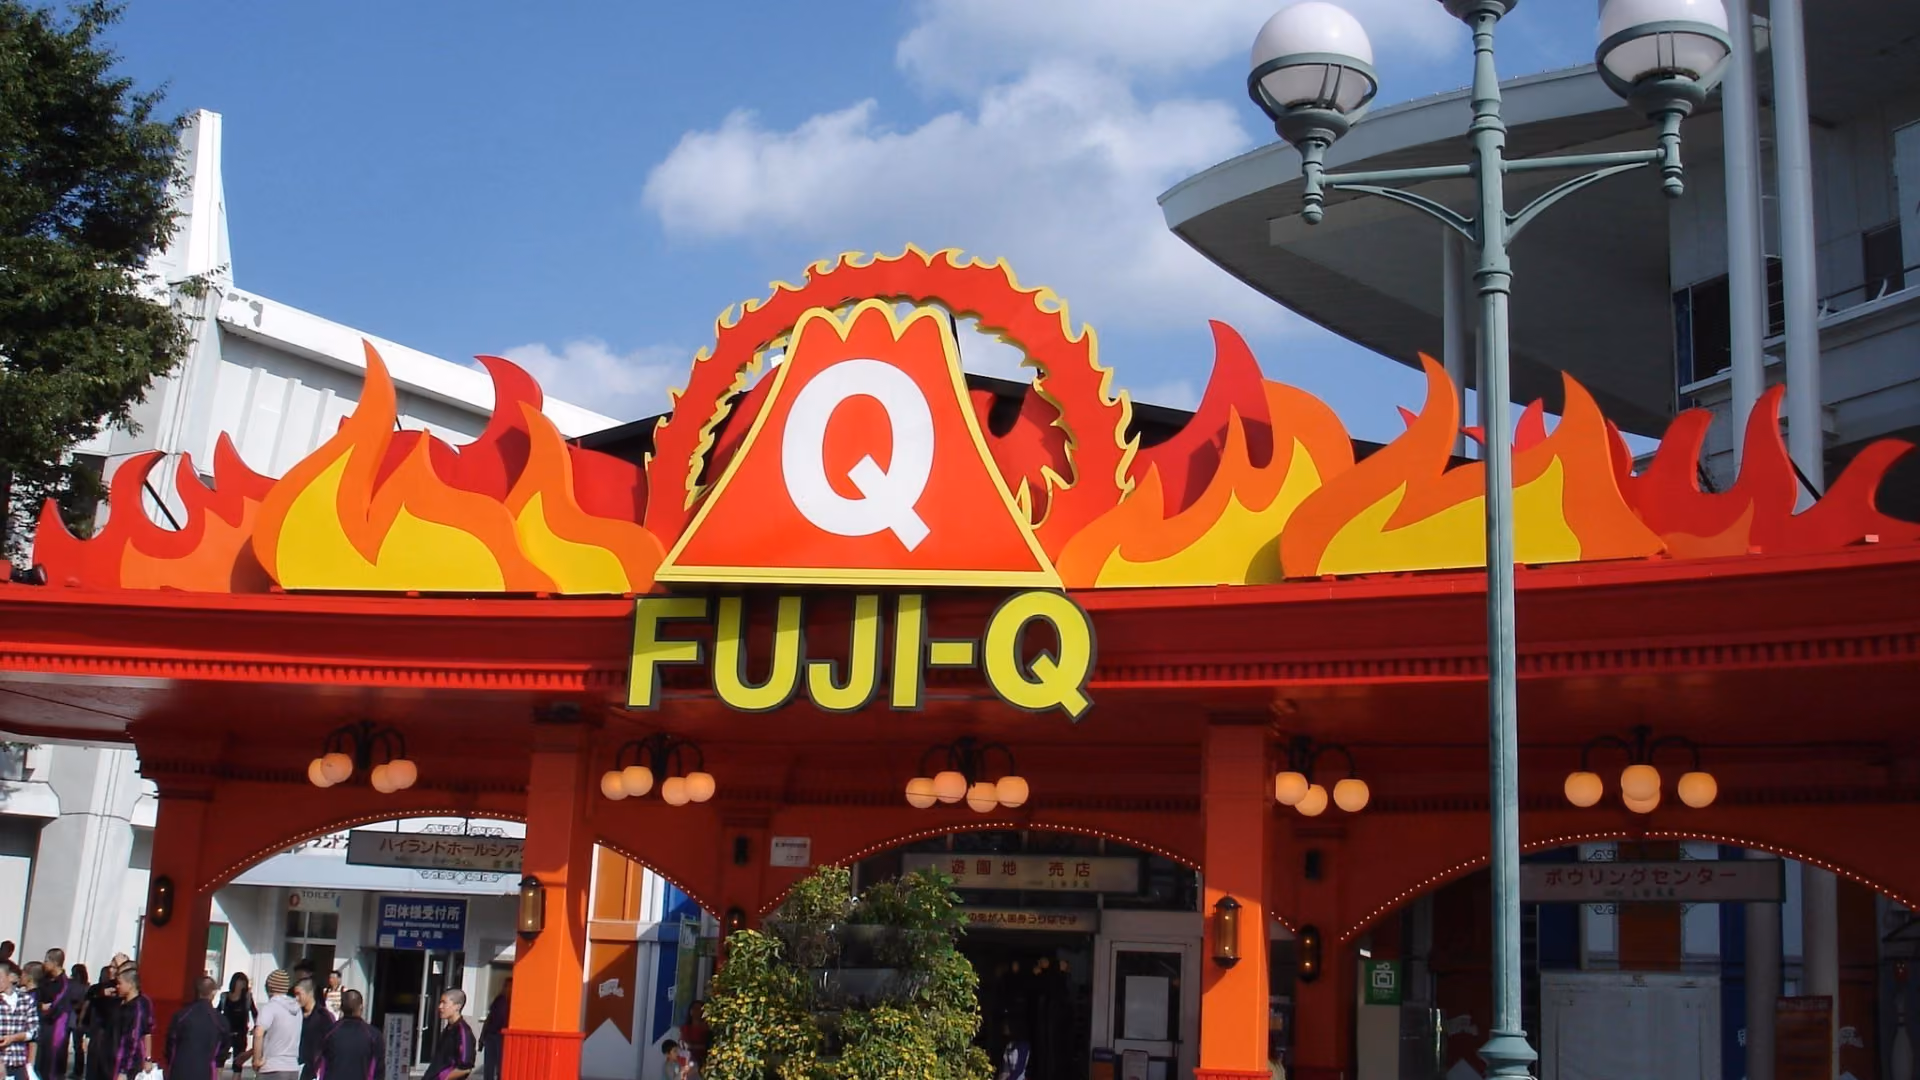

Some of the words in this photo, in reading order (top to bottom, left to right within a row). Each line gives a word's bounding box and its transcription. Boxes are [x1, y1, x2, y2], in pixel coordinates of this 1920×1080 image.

[782, 358, 935, 553] Q
[627, 591, 1092, 720] FUJI-Q
[1048, 861, 1091, 877] 売店
[1545, 867, 1737, 885] ボウリングセンター
[302, 890, 336, 900] TOILET
